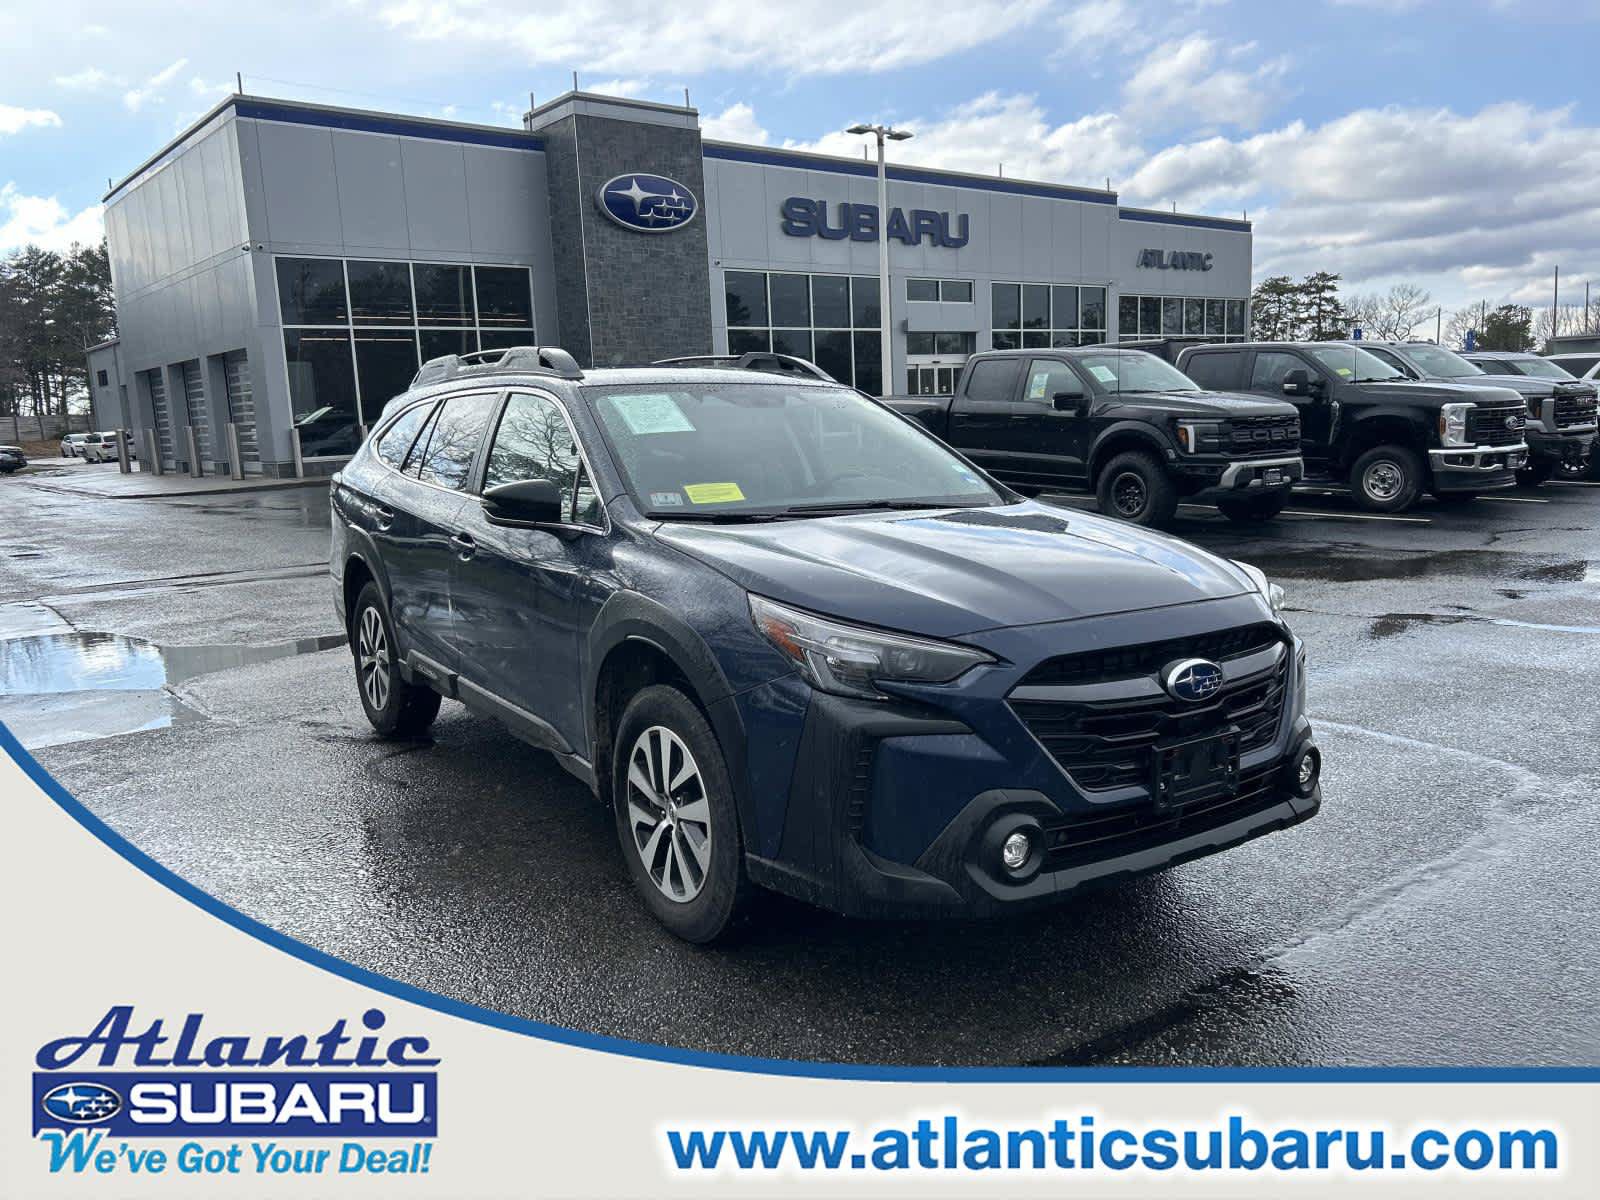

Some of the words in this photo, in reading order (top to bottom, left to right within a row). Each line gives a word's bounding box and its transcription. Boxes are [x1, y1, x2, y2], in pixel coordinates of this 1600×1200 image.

[783, 197, 969, 248] SUBARU
[1136, 248, 1214, 272] ATLANTIC
[1231, 428, 1301, 441] FORD
